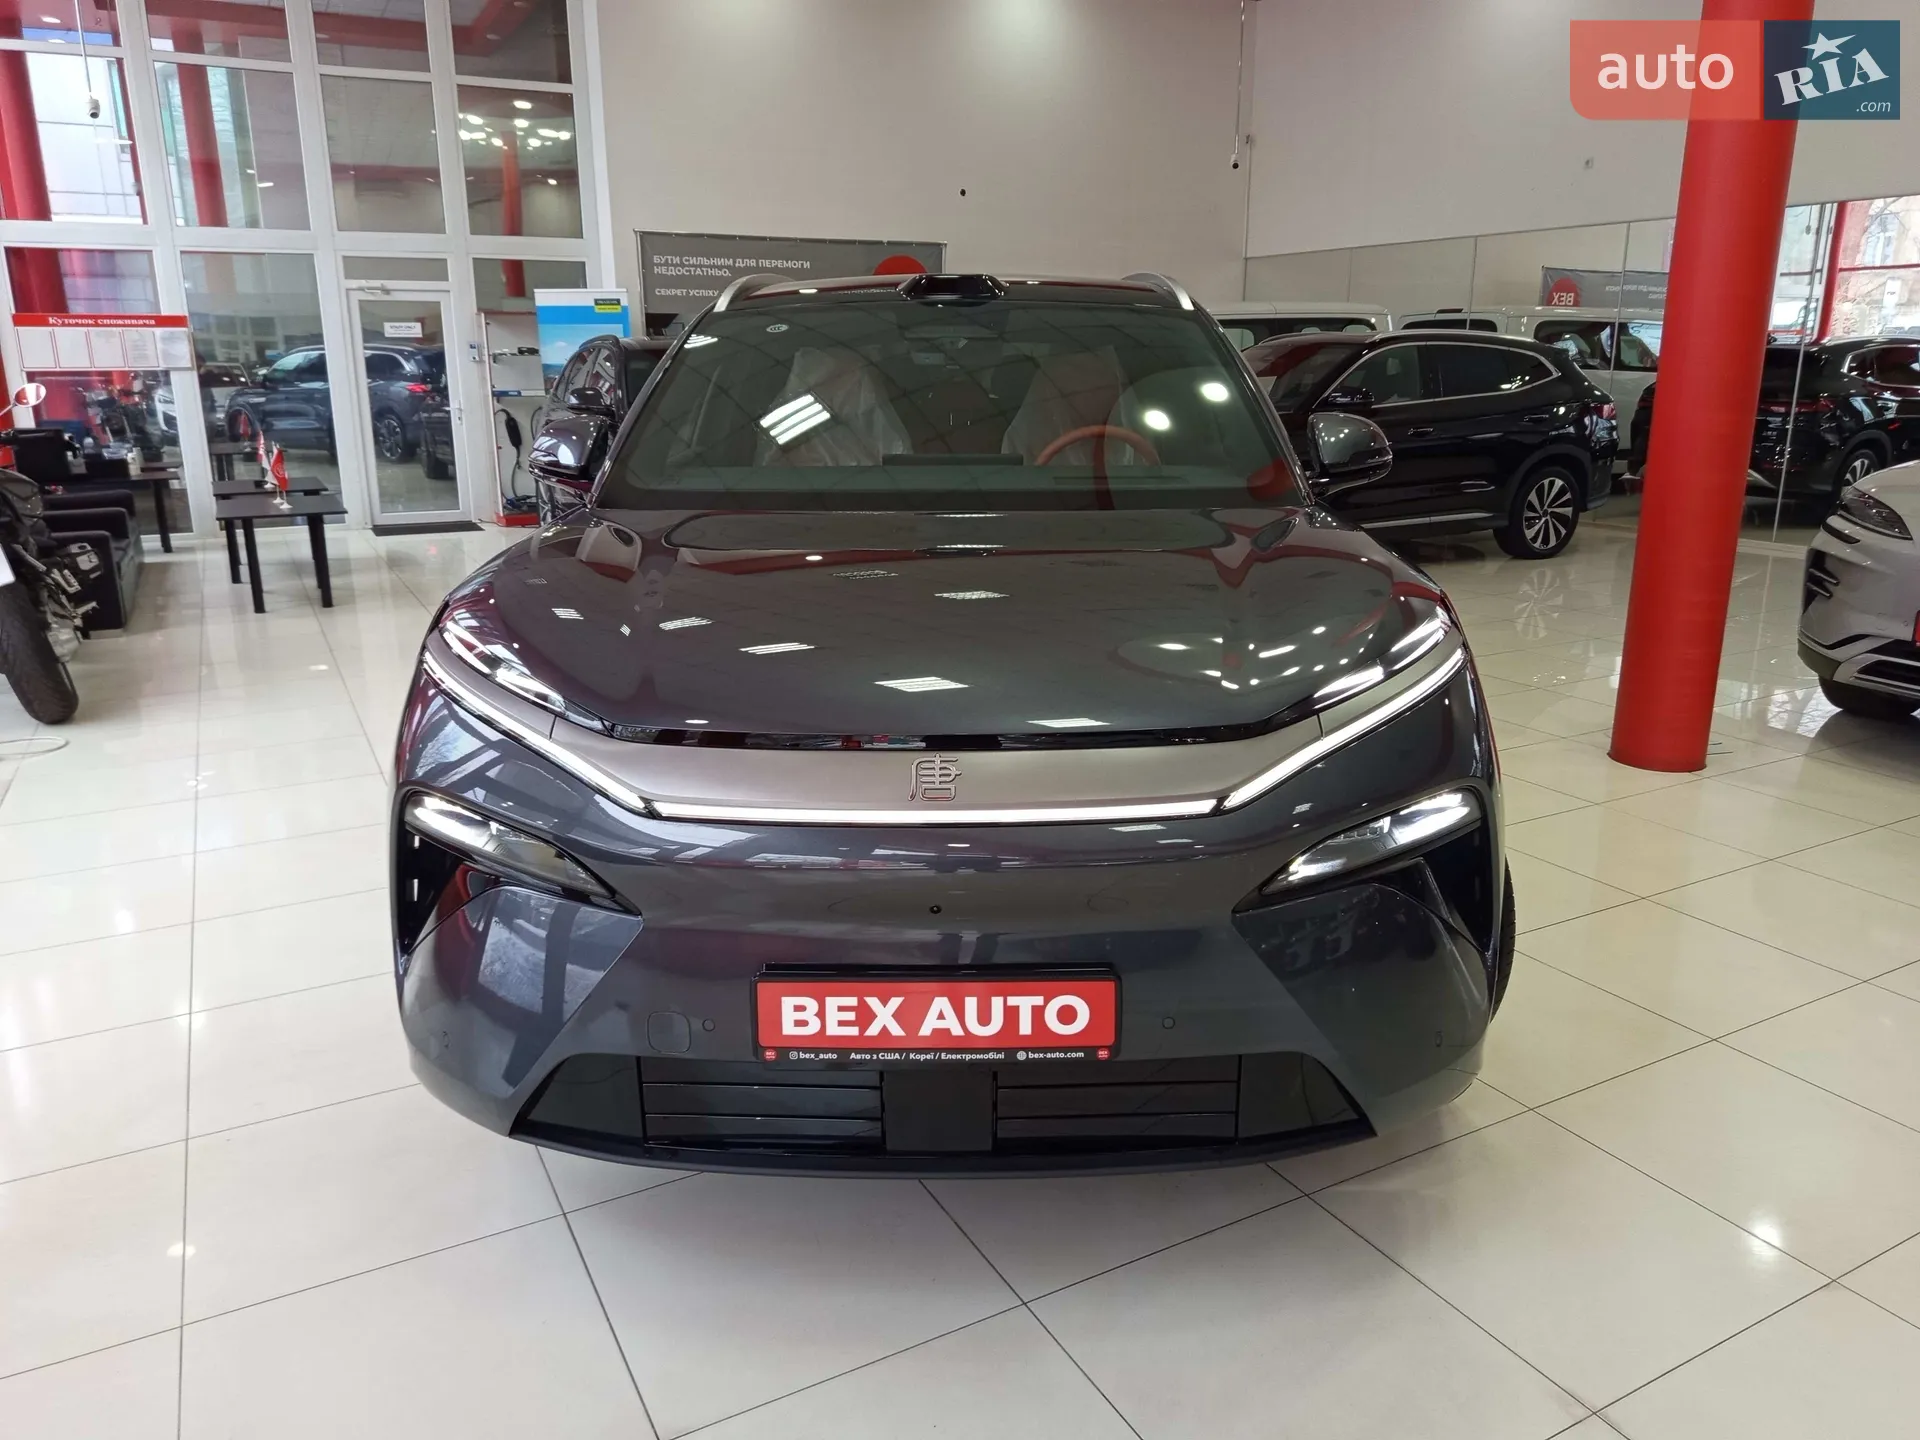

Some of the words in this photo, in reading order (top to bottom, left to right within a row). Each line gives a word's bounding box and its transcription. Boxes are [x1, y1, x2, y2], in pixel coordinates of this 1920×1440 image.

[653, 255, 680, 264] БУТИ
[683, 256, 733, 266] СИЛЬНИМ
[735, 258, 756, 267] ДЛЯ
[758, 259, 811, 268] ПЕРЕМОГИ
[653, 266, 732, 277] НЕДОСТАТНЬО.
[655, 288, 687, 296] СЕКРЕТ
[688, 289, 719, 297] УСПІХУ
[48, 316, 96, 326] Куточок
[780, 996, 906, 1036] BEX
[917, 994, 1090, 1036] AUTO
[799, 1051, 838, 1060] bex_auto
[849, 1052, 871, 1060] Авто
[878, 1052, 901, 1060] США
[909, 1052, 934, 1061] Кореї
[941, 1051, 1005, 1061] Електромобілі
[1028, 1051, 1085, 1059] bex-auto.com
